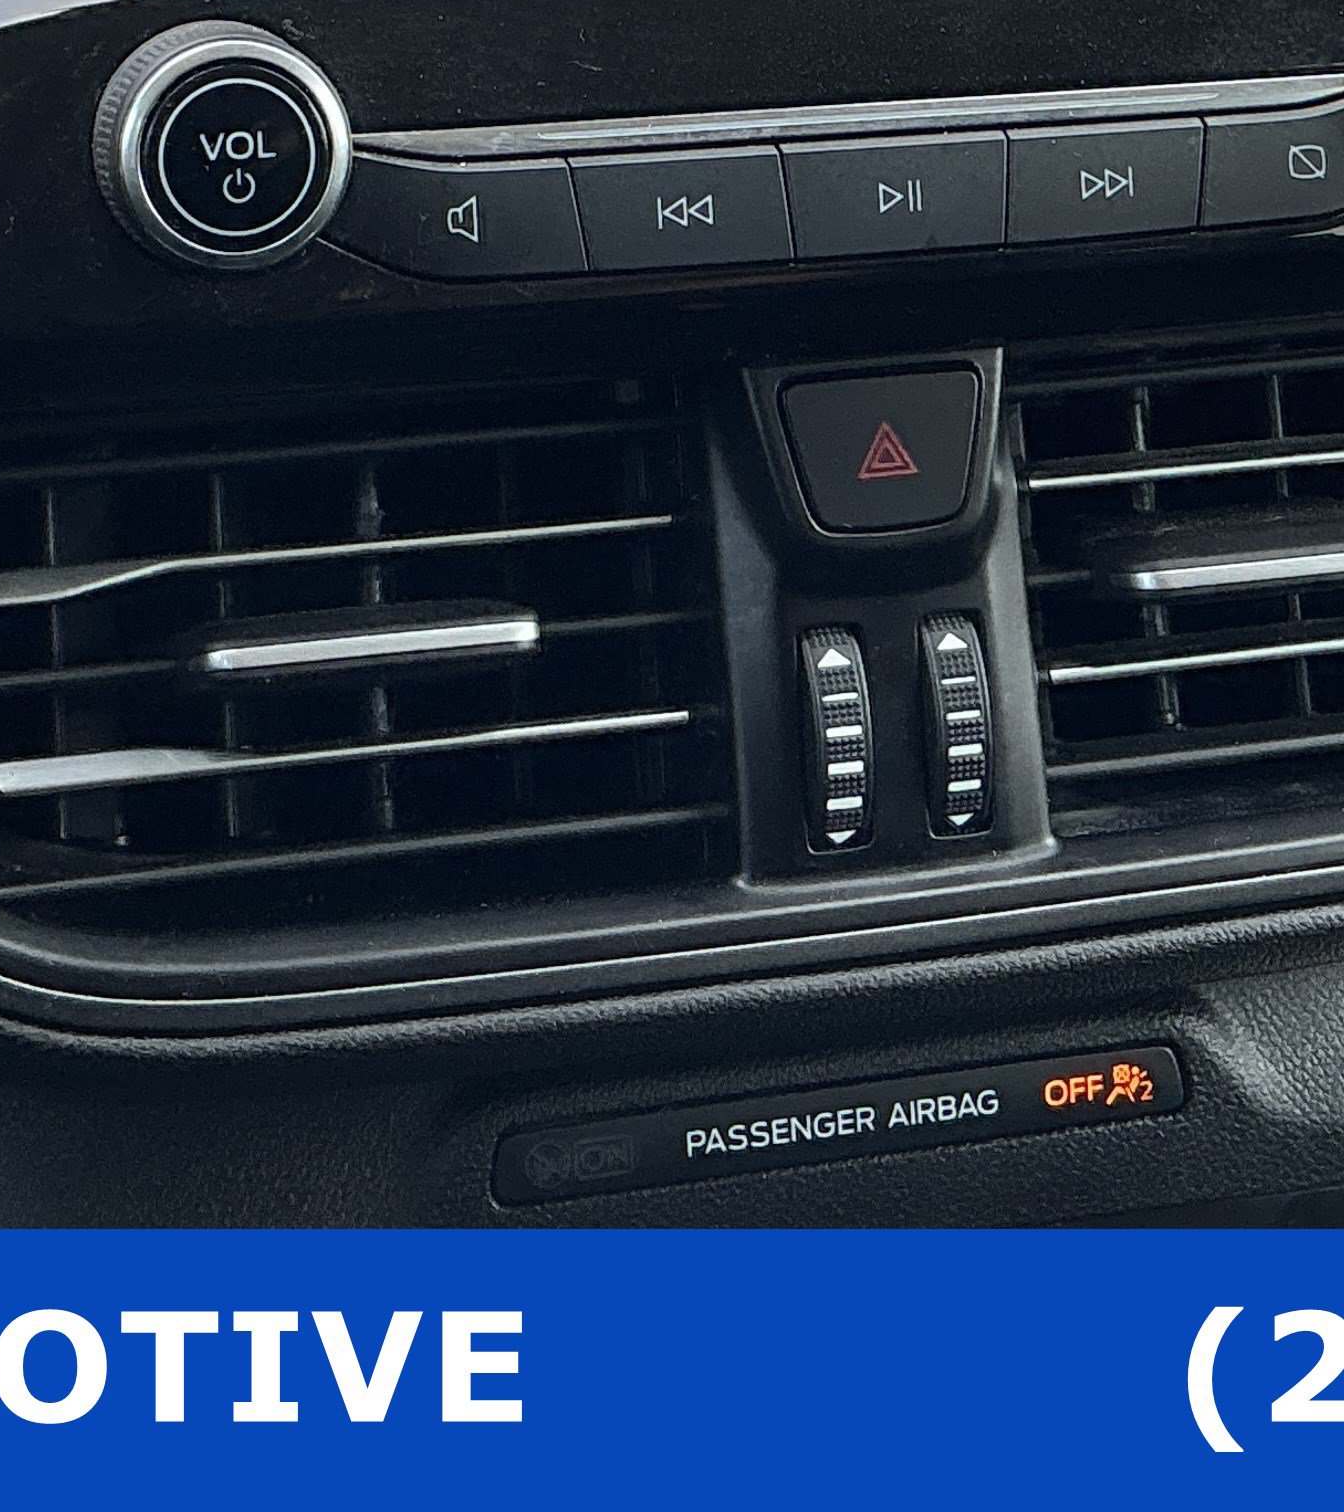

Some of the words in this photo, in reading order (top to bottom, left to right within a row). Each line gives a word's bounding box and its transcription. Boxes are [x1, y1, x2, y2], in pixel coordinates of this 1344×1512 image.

[199, 129, 278, 162] VOL
[1044, 1073, 1105, 1107] OFF
[685, 1106, 876, 1159] PASSENGER
[888, 1089, 1000, 1129] AIRBAG
